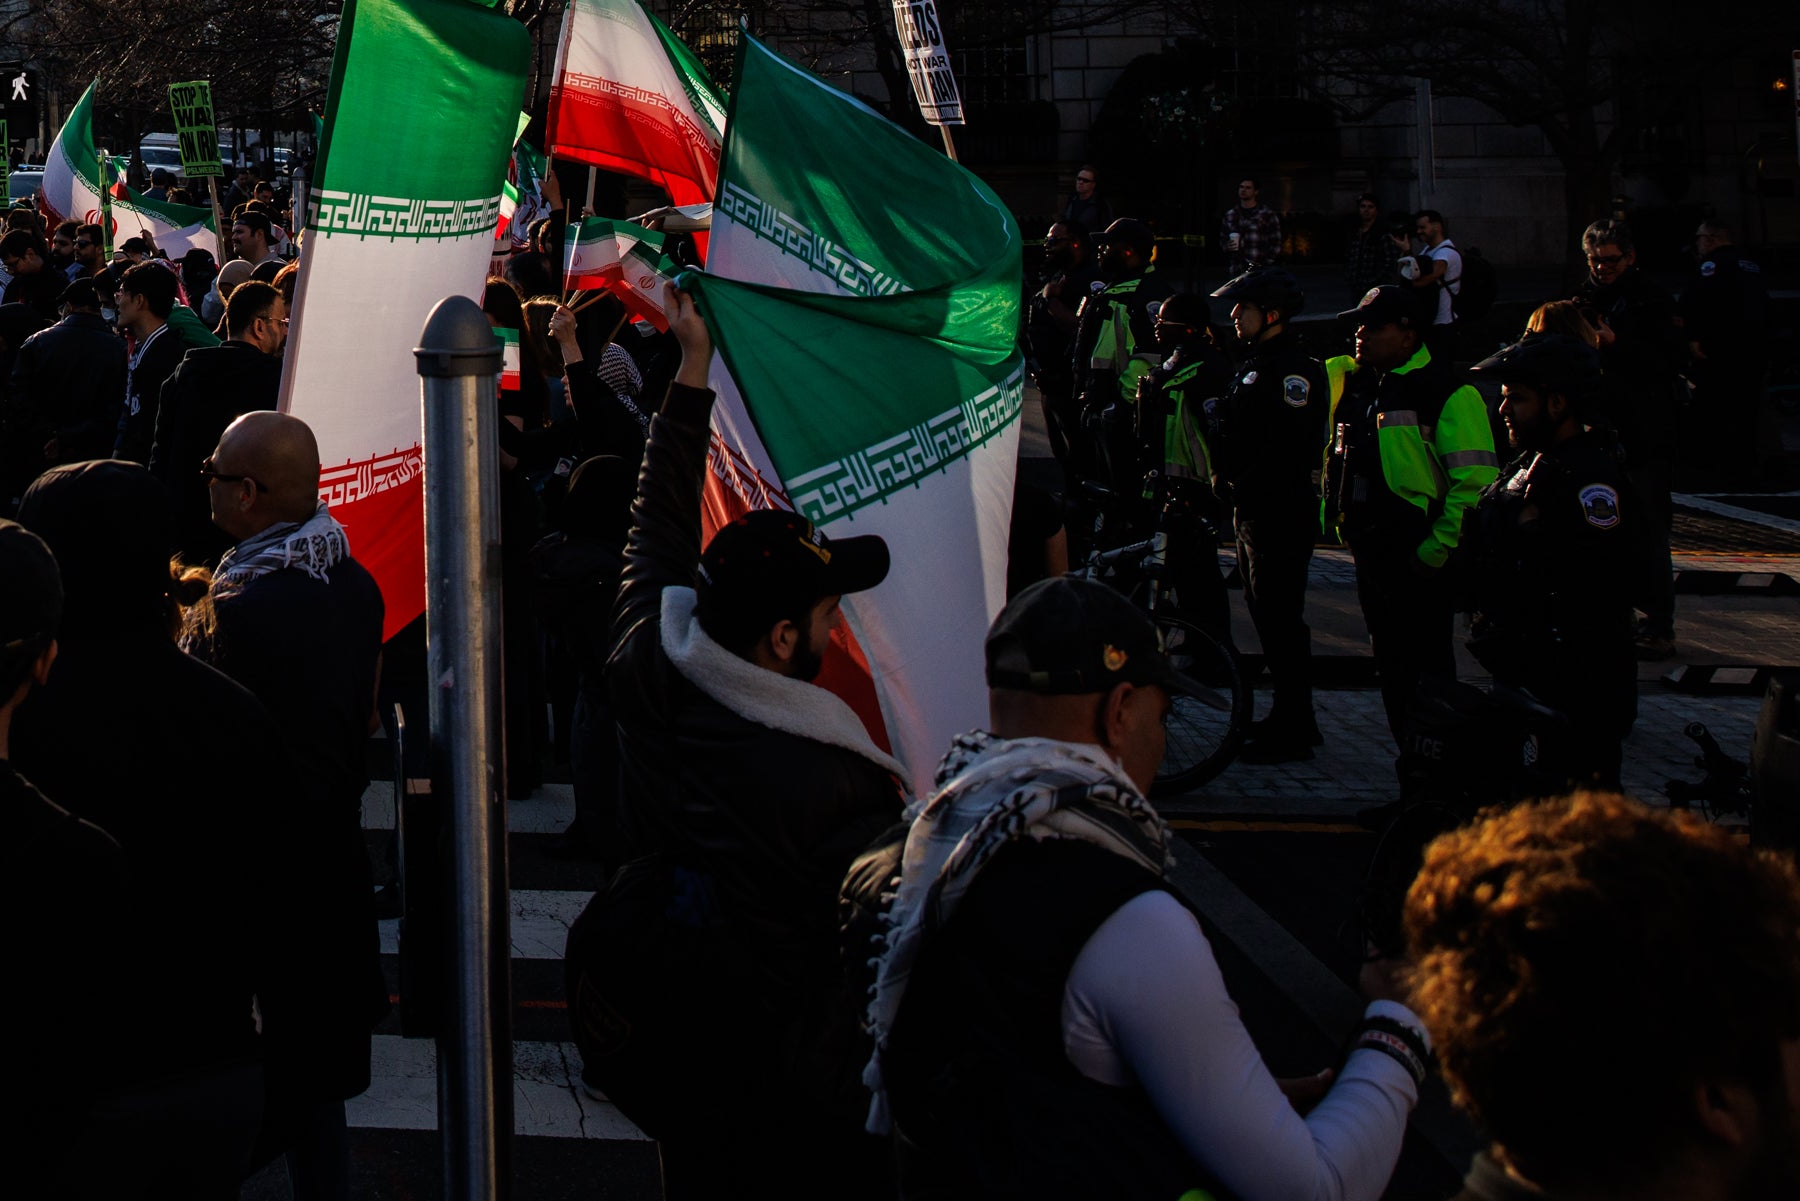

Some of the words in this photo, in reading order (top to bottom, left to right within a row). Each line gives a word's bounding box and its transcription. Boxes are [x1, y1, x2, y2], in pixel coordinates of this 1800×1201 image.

[922, 55, 947, 69] WAR
[171, 86, 197, 108] STOP
[198, 85, 209, 106] TE
[179, 131, 199, 162] ON
